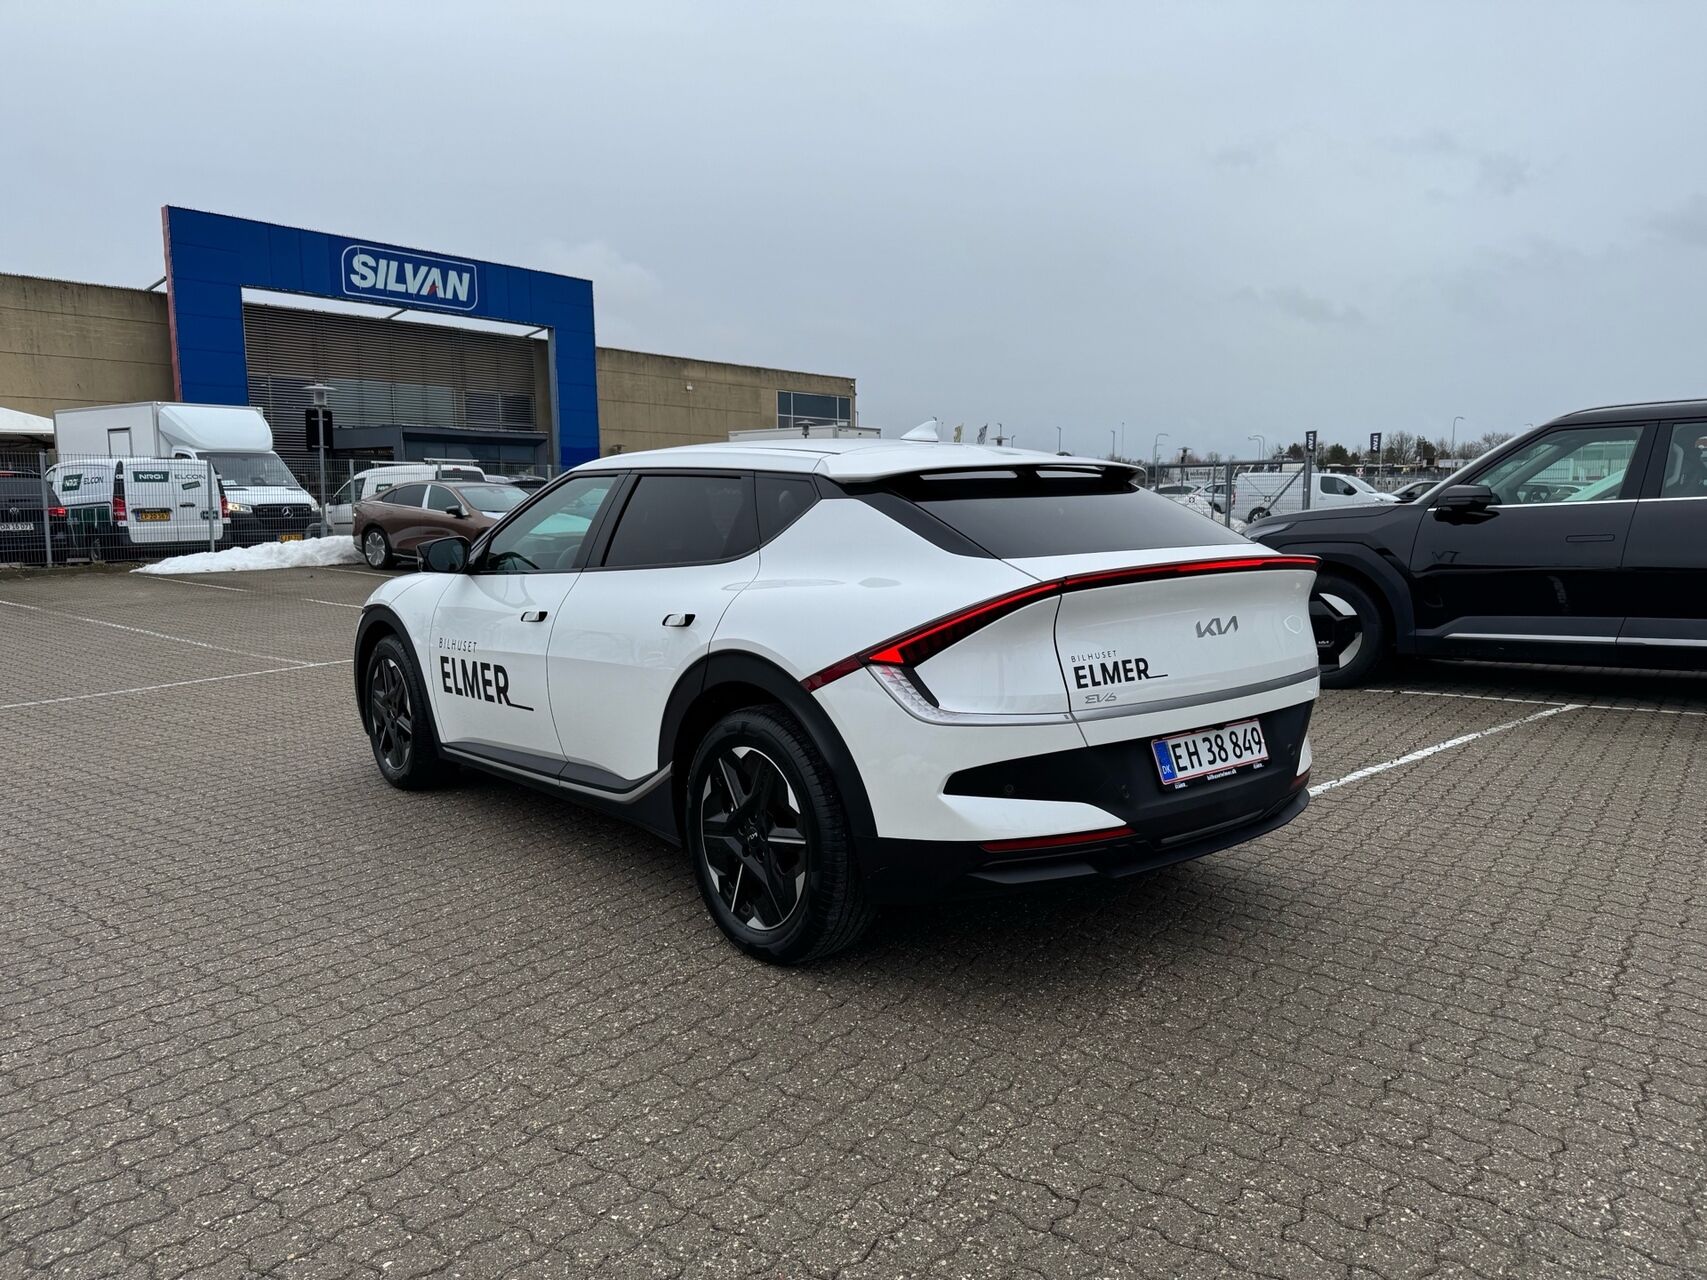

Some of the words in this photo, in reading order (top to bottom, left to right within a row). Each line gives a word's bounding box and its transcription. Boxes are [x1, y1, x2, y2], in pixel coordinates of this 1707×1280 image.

[350, 254, 470, 302] SILVAN
[84, 476, 104, 485] ELCON
[1196, 616, 1239, 638] KIA
[439, 637, 478, 654] BILHUSET
[1071, 650, 1117, 663] BILHUSET
[1085, 692, 1117, 704] EV6
[1171, 740, 1202, 772] EH
[1206, 734, 1229, 765] 38
[1229, 727, 1262, 759] 849
[1161, 764, 1173, 775] DK
